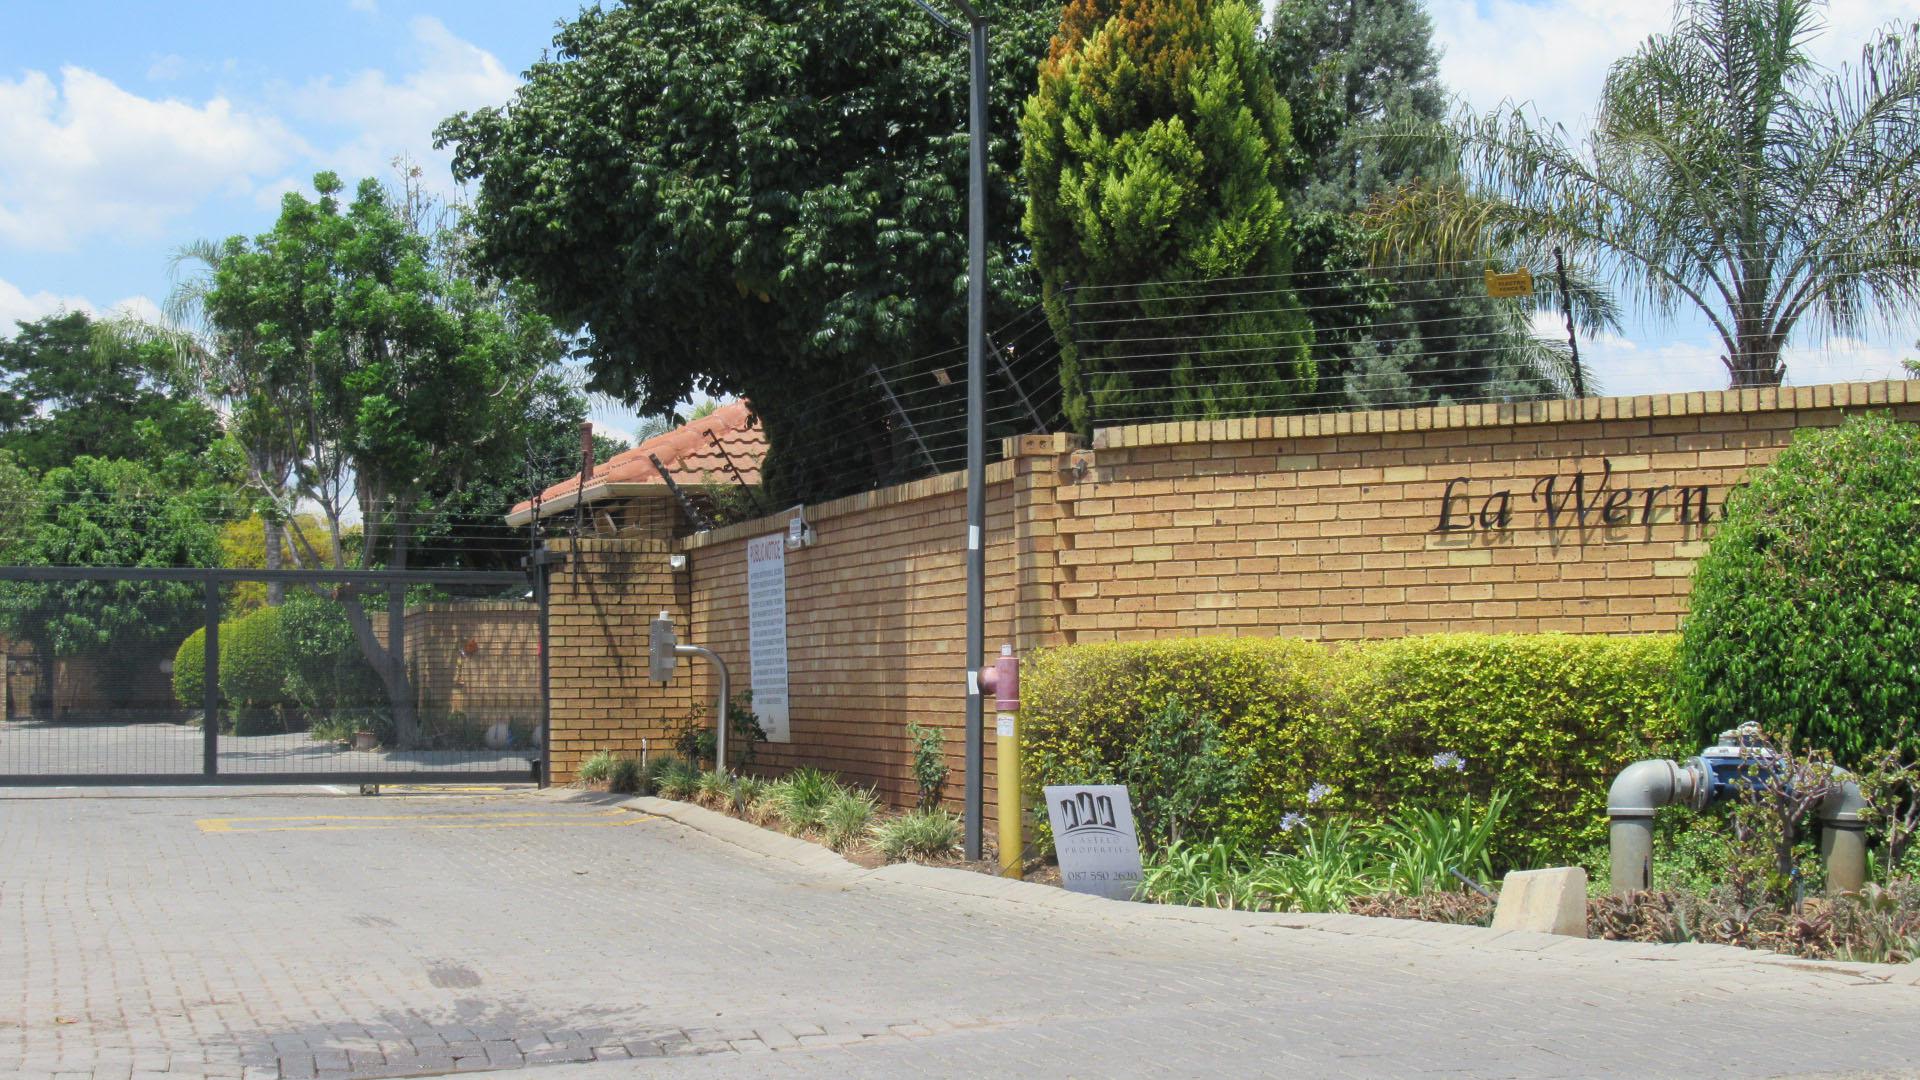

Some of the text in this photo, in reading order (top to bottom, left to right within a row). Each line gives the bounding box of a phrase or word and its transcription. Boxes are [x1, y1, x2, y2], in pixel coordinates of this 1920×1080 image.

[1430, 476, 1512, 532] La
[1064, 845, 1131, 855] PROPERTIES
[1067, 871, 1087, 881] 087
[1090, 871, 1110, 881] 550
